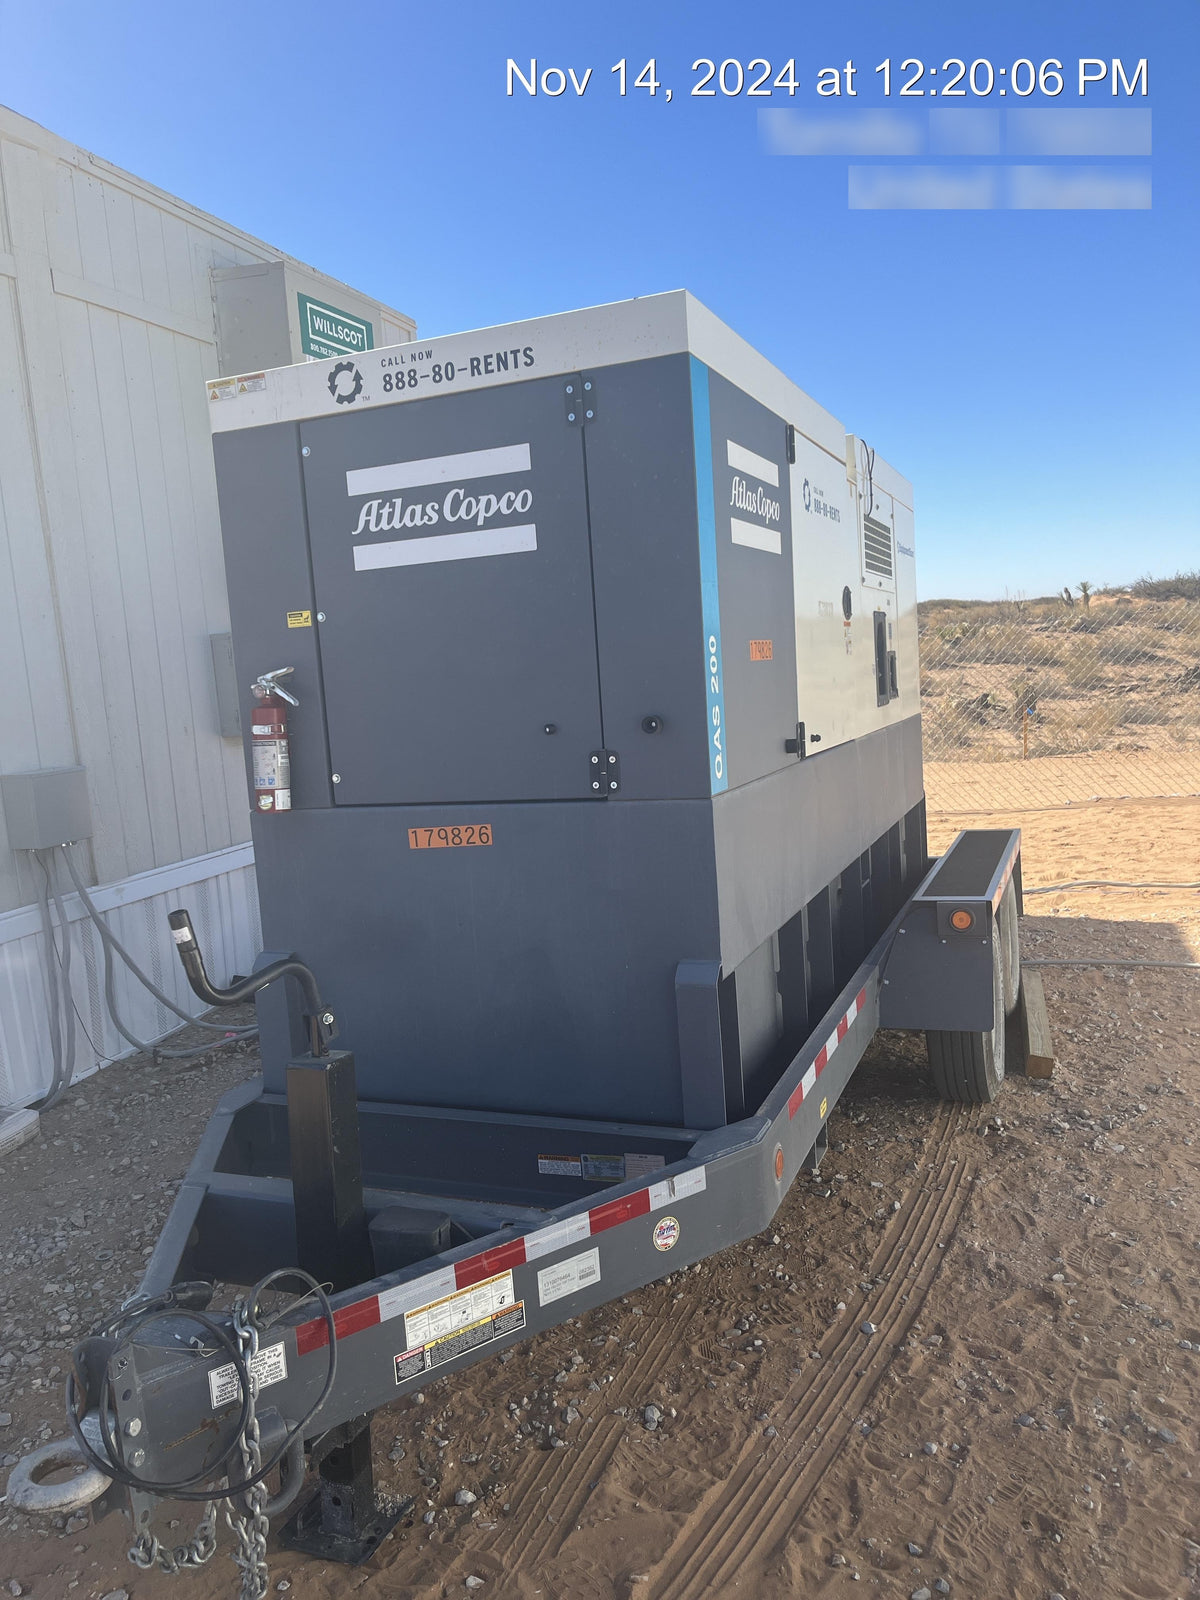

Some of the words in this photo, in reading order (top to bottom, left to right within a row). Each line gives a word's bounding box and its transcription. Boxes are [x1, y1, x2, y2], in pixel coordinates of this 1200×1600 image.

[312, 315, 362, 347] WILLSCOT
[381, 355, 406, 368] CALL
[410, 350, 433, 362] NOW
[382, 346, 535, 393] 888-80-RENTS
[351, 498, 439, 535] Atlas
[443, 488, 533, 526] Copco
[730, 476, 757, 513] Atlas
[757, 486, 780, 524] Copco
[708, 635, 720, 694] 200
[712, 705, 723, 779] QAS
[411, 825, 490, 848] 179826
